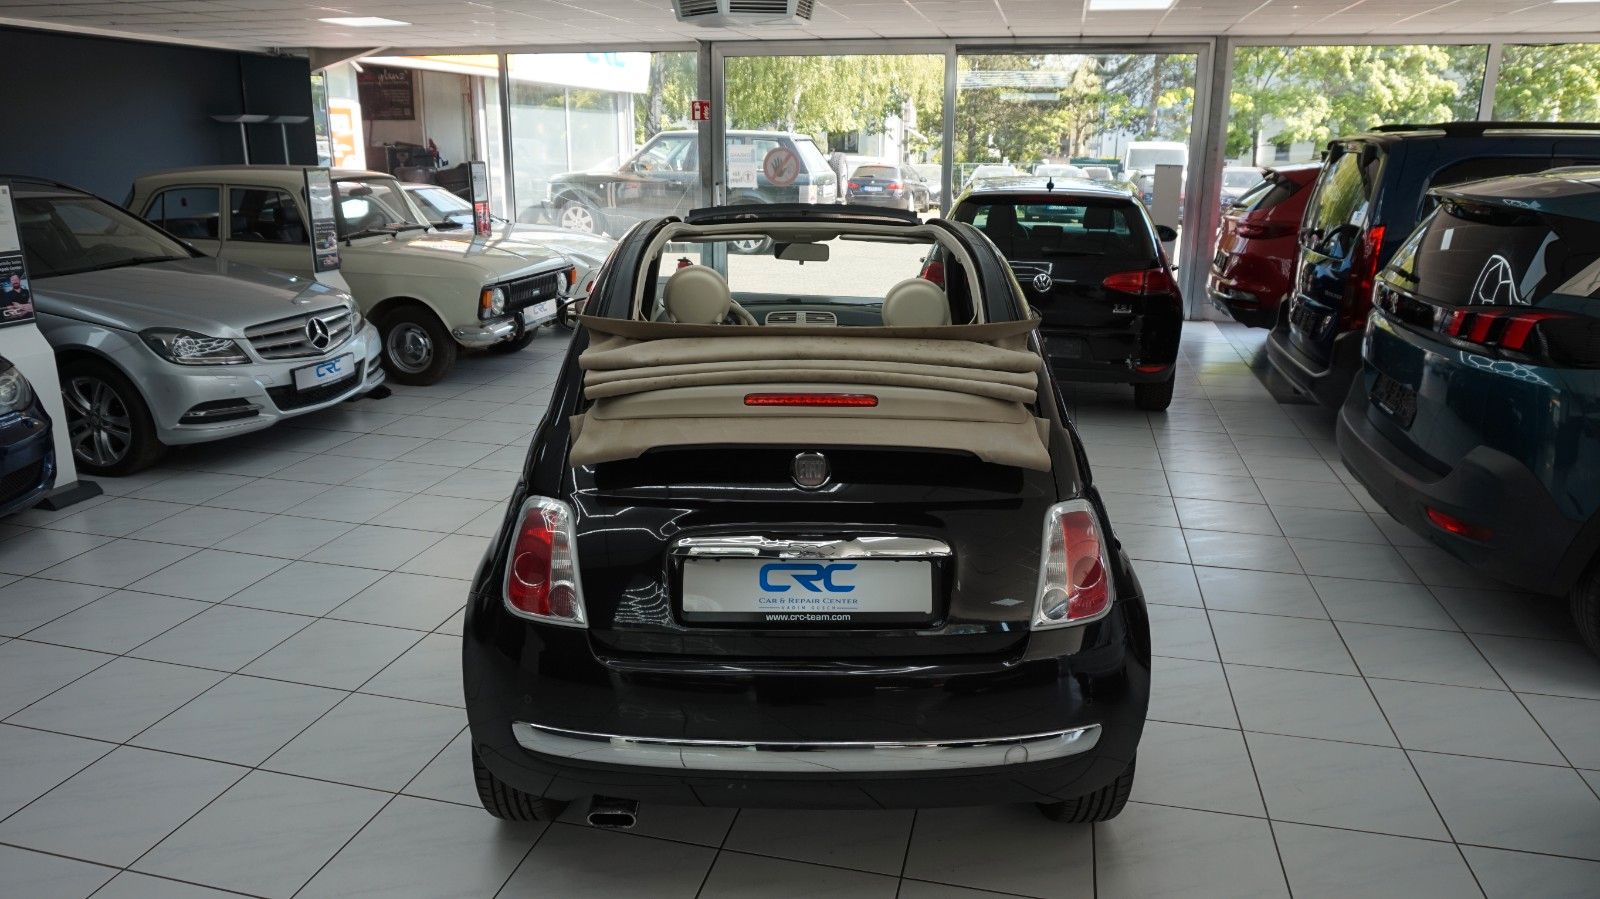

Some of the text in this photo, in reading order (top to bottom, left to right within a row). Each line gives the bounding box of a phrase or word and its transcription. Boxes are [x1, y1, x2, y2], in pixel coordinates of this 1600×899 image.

[316, 359, 341, 377] CRC
[759, 563, 858, 593] CRC
[765, 613, 851, 621] www.crc-team.com
